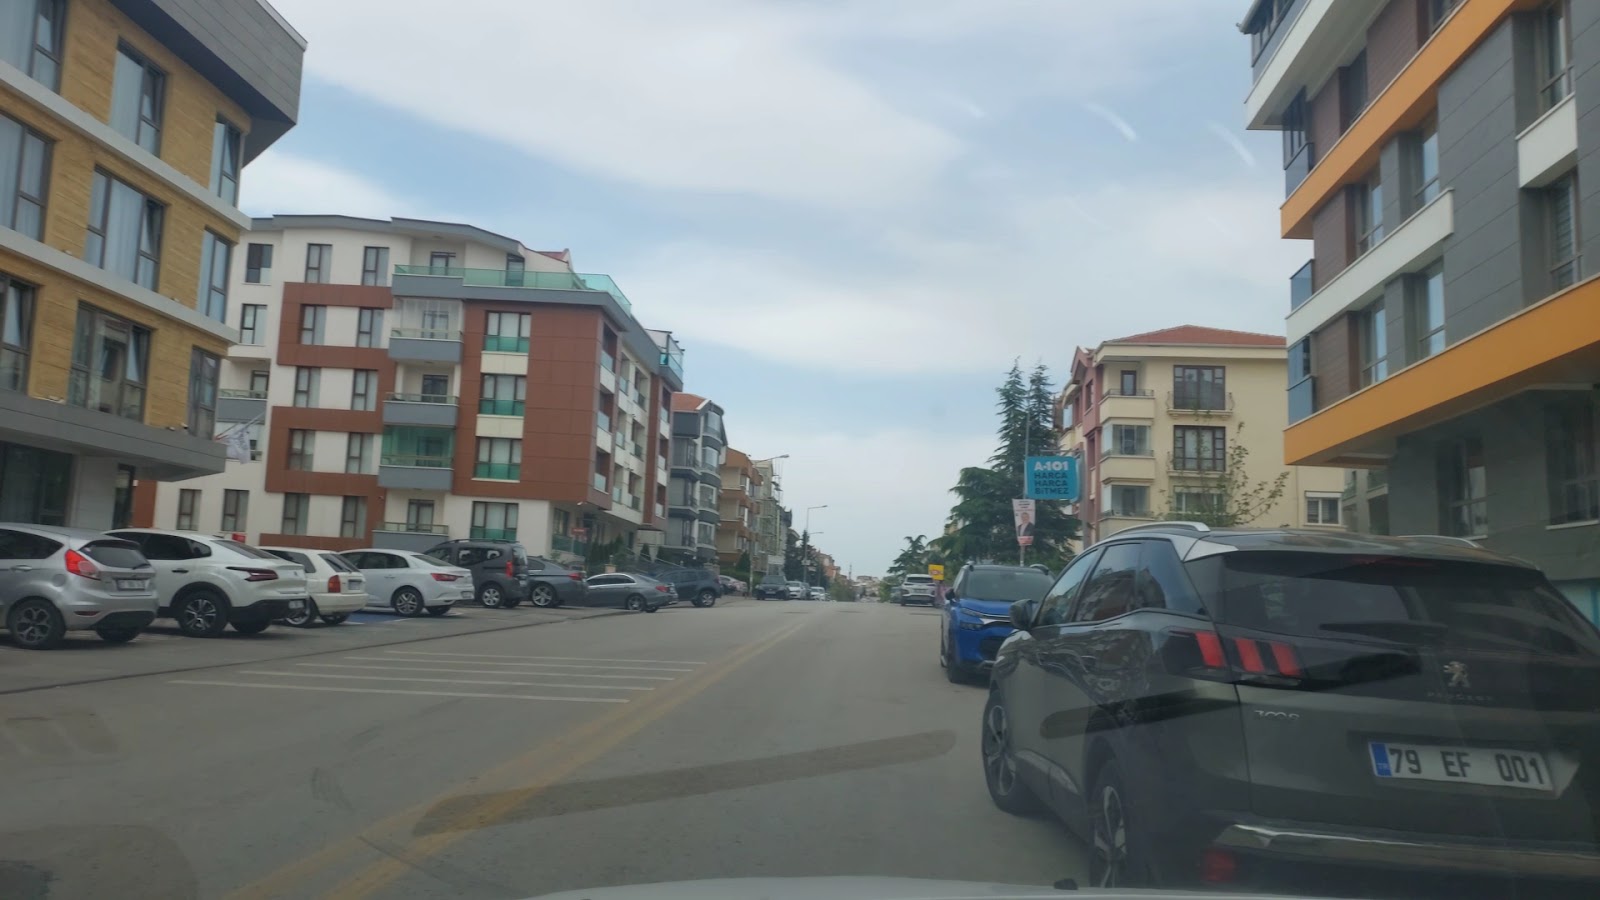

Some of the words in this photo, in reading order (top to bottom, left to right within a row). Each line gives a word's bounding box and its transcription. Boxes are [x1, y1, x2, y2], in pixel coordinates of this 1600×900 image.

[1389, 748, 1422, 774] 79
[1440, 751, 1471, 777] EF
[1495, 754, 1544, 784] 001
